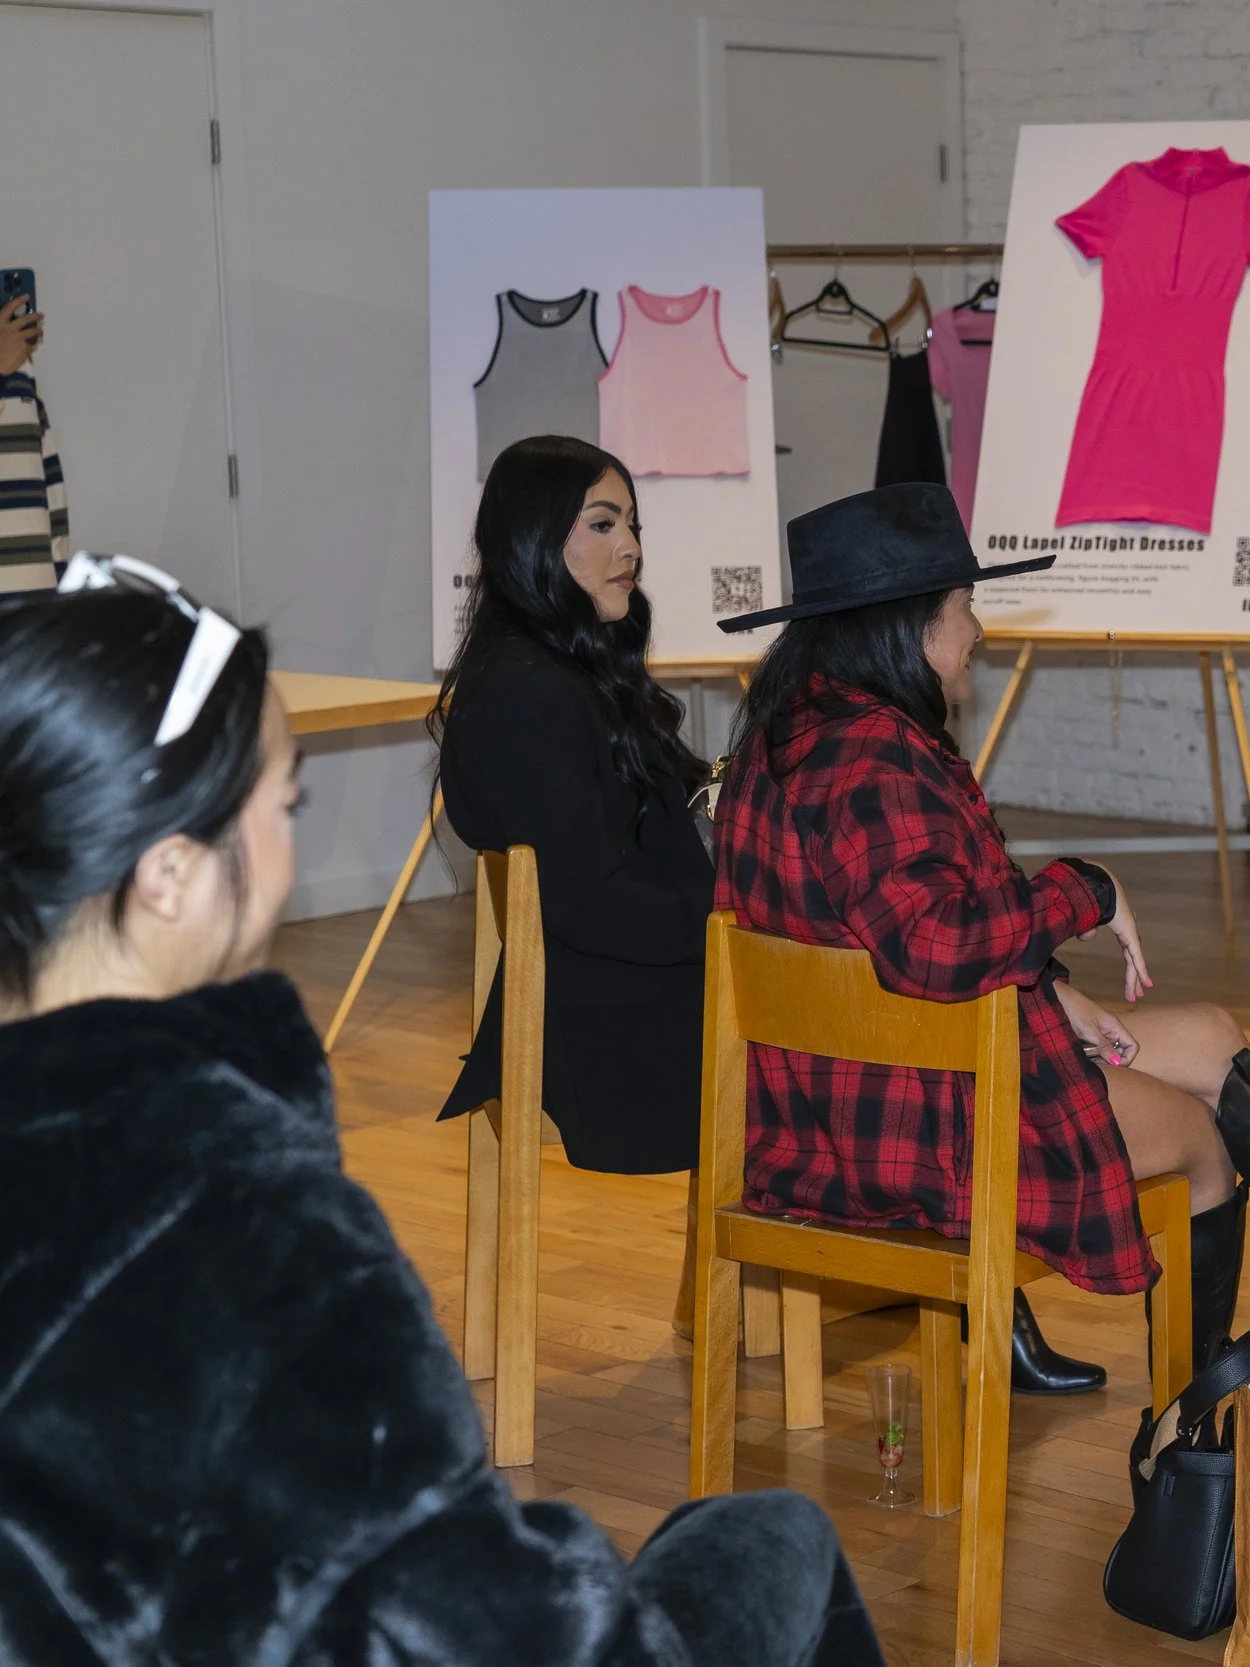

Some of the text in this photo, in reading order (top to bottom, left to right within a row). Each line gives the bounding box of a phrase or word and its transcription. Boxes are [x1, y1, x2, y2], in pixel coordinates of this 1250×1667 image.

[1023, 535, 1065, 552] Lapel
[1069, 536, 1134, 553] ZipTight
[1139, 537, 1205, 551] Dresses
